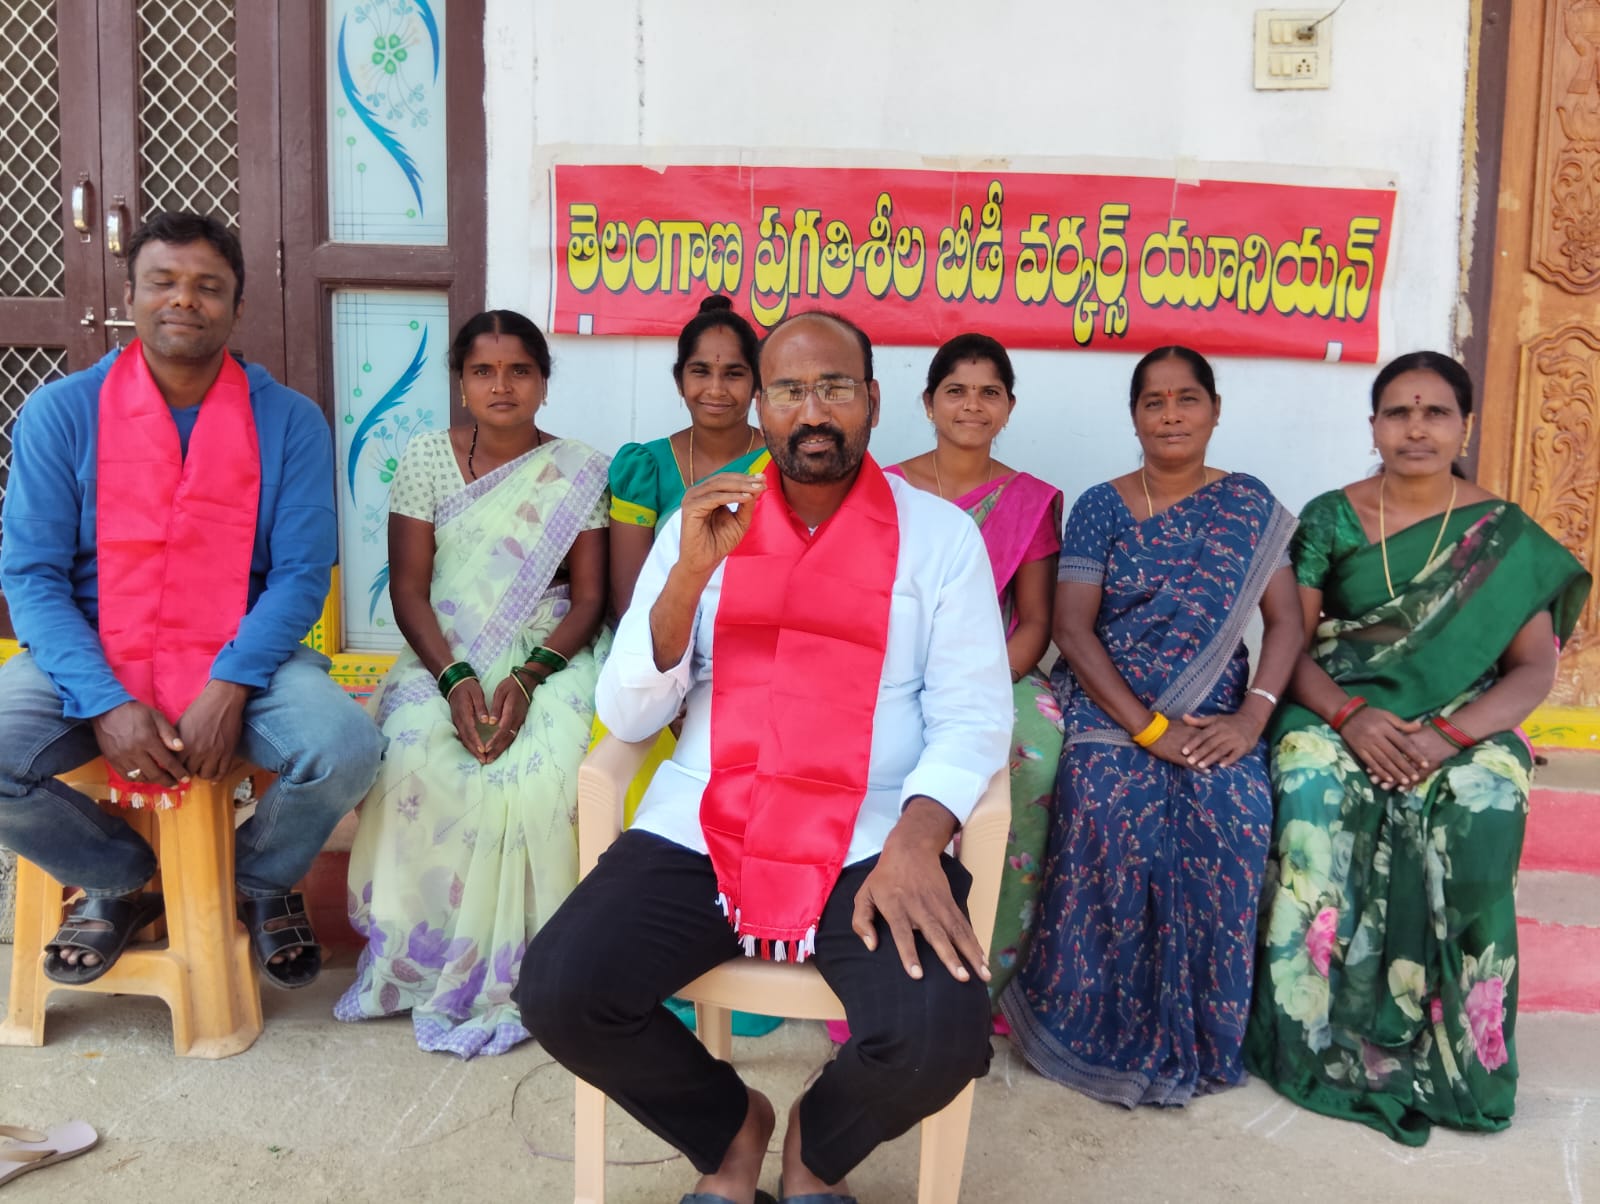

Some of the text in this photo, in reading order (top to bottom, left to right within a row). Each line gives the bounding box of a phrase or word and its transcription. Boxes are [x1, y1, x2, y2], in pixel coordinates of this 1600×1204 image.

[566, 179, 1382, 346] తెలంగాణ ప్రగతిశీల బీడీ వర్కర్స్ యూనియన్
